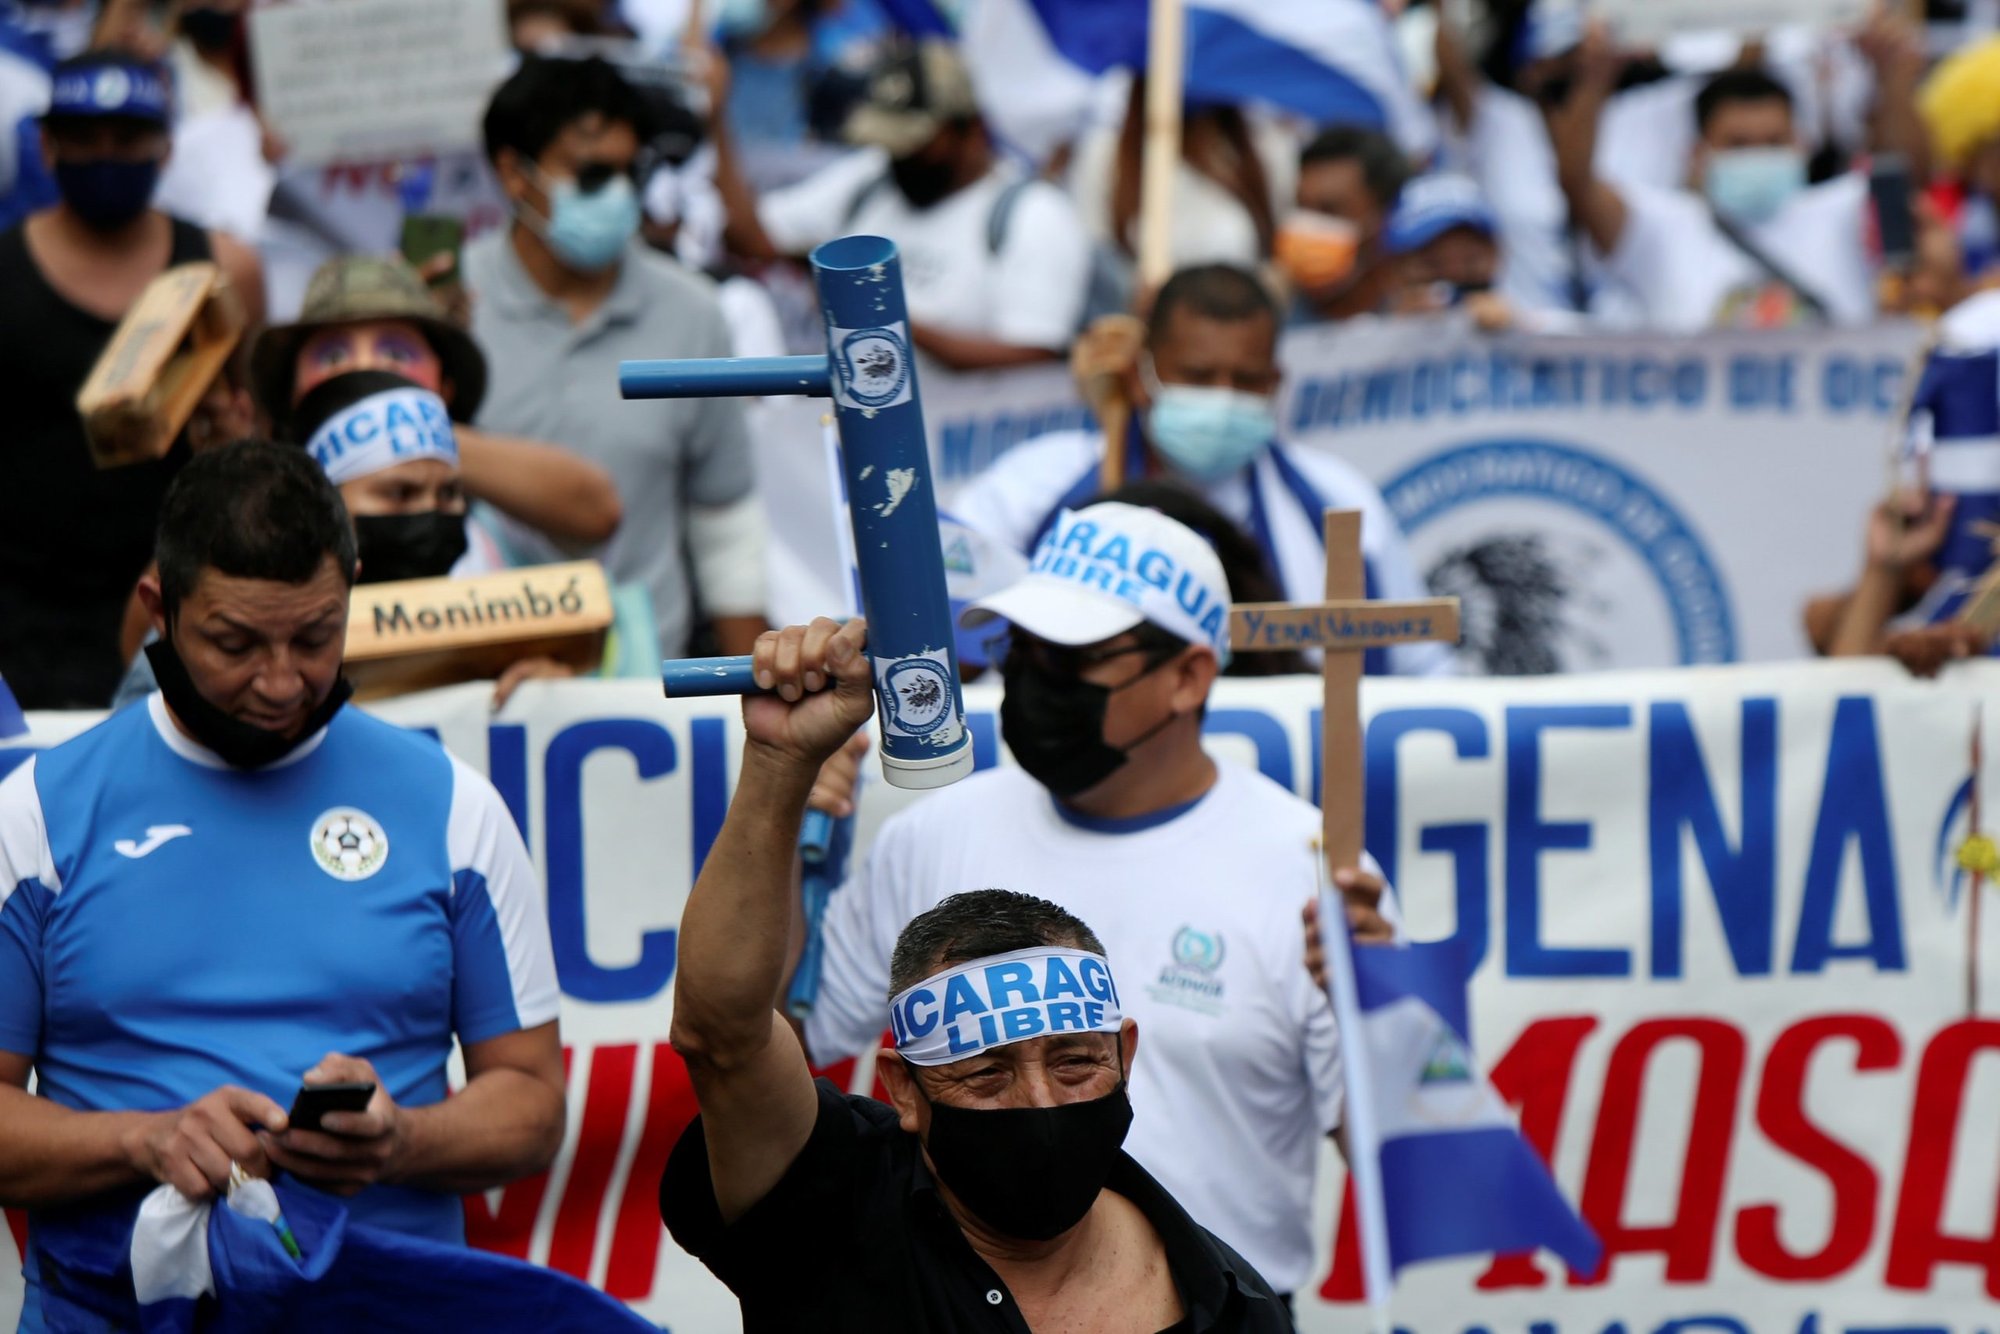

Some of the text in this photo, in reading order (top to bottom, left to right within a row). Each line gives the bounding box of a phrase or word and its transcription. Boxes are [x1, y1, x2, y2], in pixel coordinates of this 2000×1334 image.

[1729, 355, 1796, 413] DE
[372, 576, 583, 635] Monimbó
[890, 956, 1120, 1048] ICARAG
[947, 1001, 1103, 1055] LIBRE
